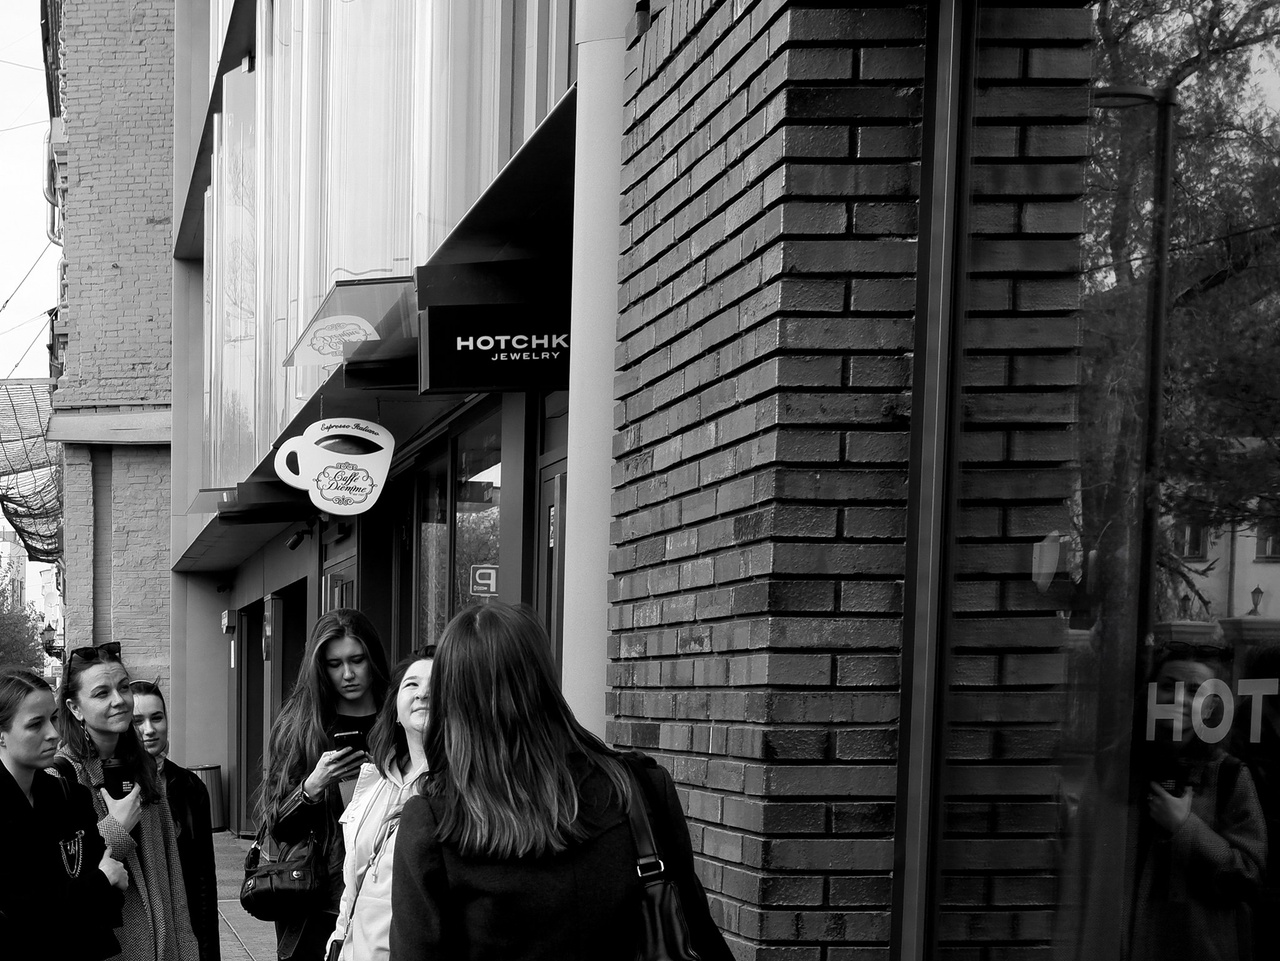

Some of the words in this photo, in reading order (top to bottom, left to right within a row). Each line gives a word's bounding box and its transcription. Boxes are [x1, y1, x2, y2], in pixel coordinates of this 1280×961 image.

[456, 334, 569, 350] HOTCHK
[491, 351, 560, 361] JEWELRY
[320, 423, 350, 432] Espresso
[351, 423, 380, 436] Italiano
[322, 480, 368, 495] Diemme
[1146, 678, 1279, 744] HOT
